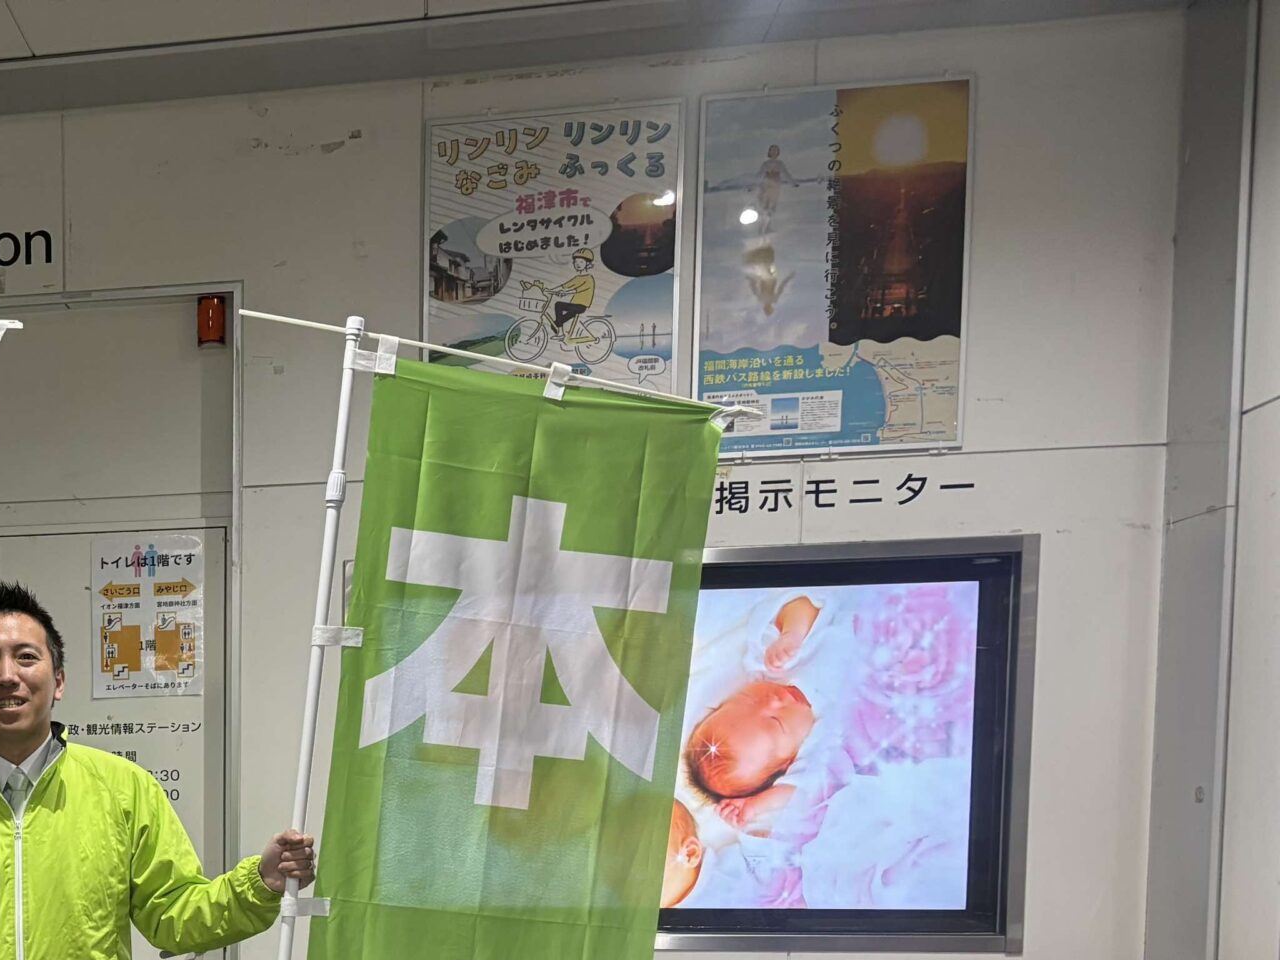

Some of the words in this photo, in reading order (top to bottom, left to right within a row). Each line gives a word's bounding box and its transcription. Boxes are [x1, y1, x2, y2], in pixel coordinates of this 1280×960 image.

[437, 126, 550, 166] リンリン
[563, 119, 671, 147] リンリン
[455, 160, 541, 195] なごみ
[515, 188, 592, 215] 福津市で
[499, 214, 593, 235] レンタサイクル
[714, 472, 975, 515] 掲示モニター
[100, 552, 196, 570] トイレは1階です
[156, 585, 188, 594] みやじ口
[139, 639, 157, 652] 1階
